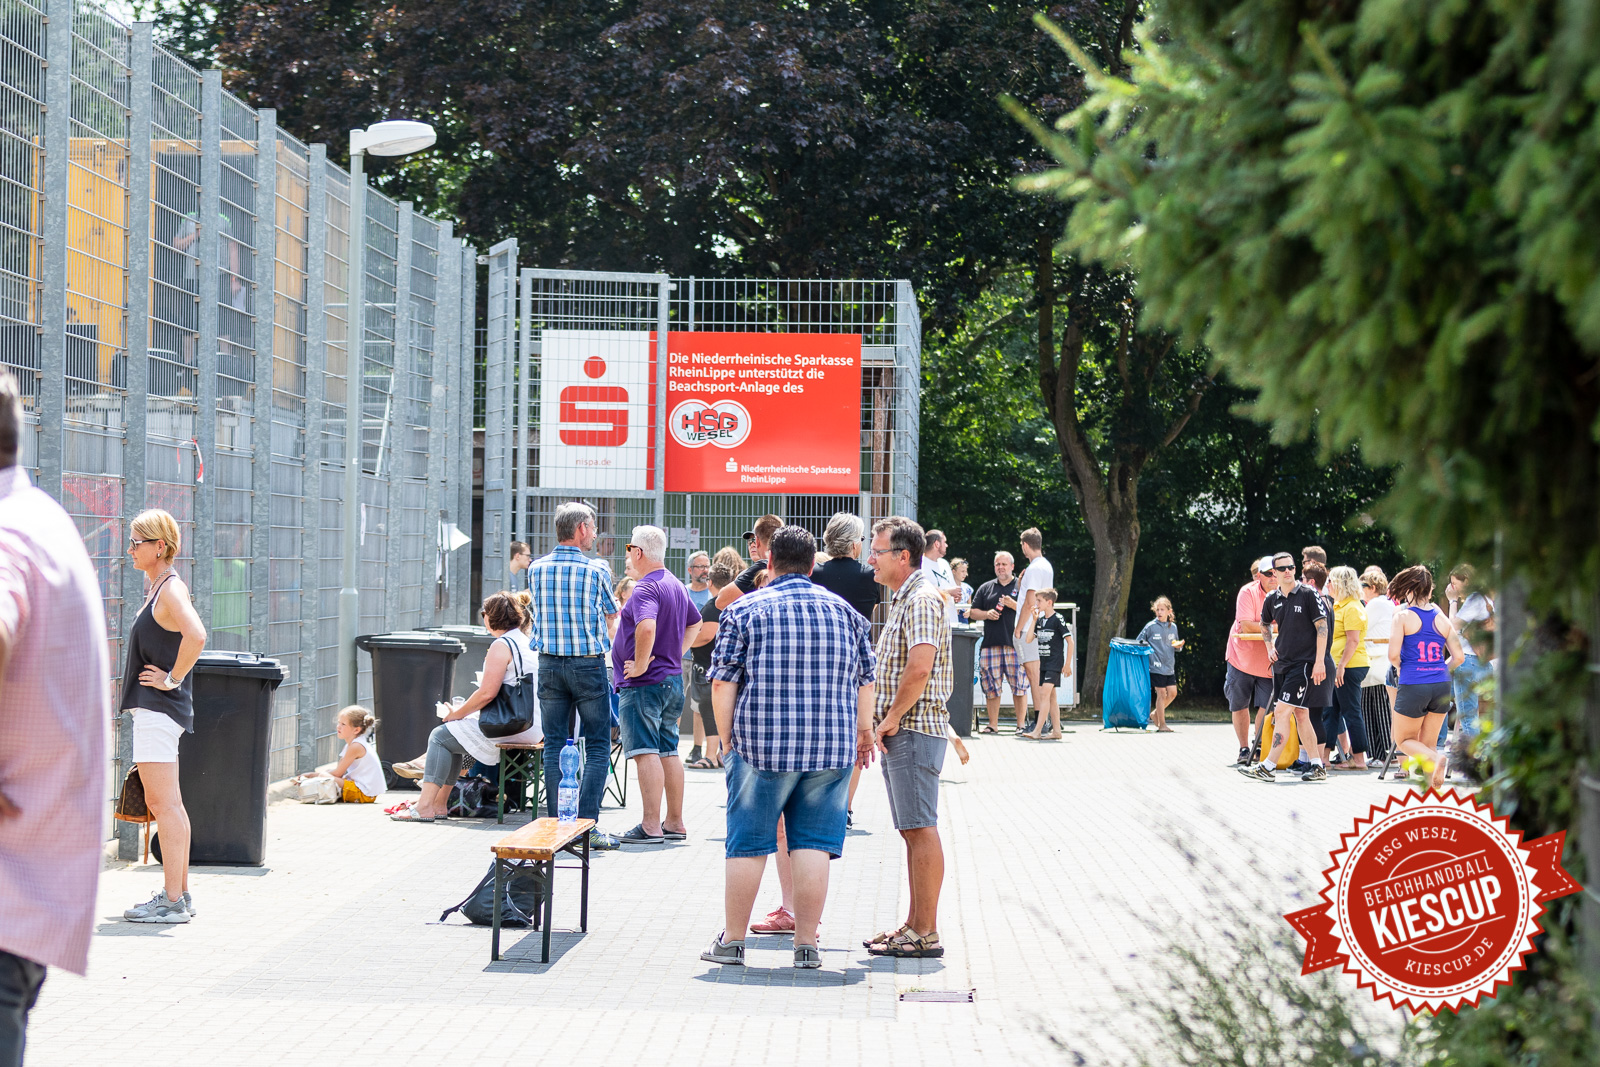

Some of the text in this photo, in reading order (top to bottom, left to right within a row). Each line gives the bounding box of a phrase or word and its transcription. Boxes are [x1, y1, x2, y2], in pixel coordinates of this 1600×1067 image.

[669, 353, 854, 368] Die Niederrheinische Sparkasse
[669, 367, 825, 379] RheinLippe unterstützt die
[669, 381, 804, 395] Beachsport-Anlage des
[682, 409, 738, 433] HSG
[687, 429, 733, 440] WESEL
[576, 458, 611, 467] nispa.de
[741, 464, 851, 476] Niederrheinische Sparkasse
[741, 475, 786, 484] RheinLippe
[1294, 605, 1302, 613] TR
[1417, 641, 1441, 662] 10
[1282, 692, 1291, 702] 13
